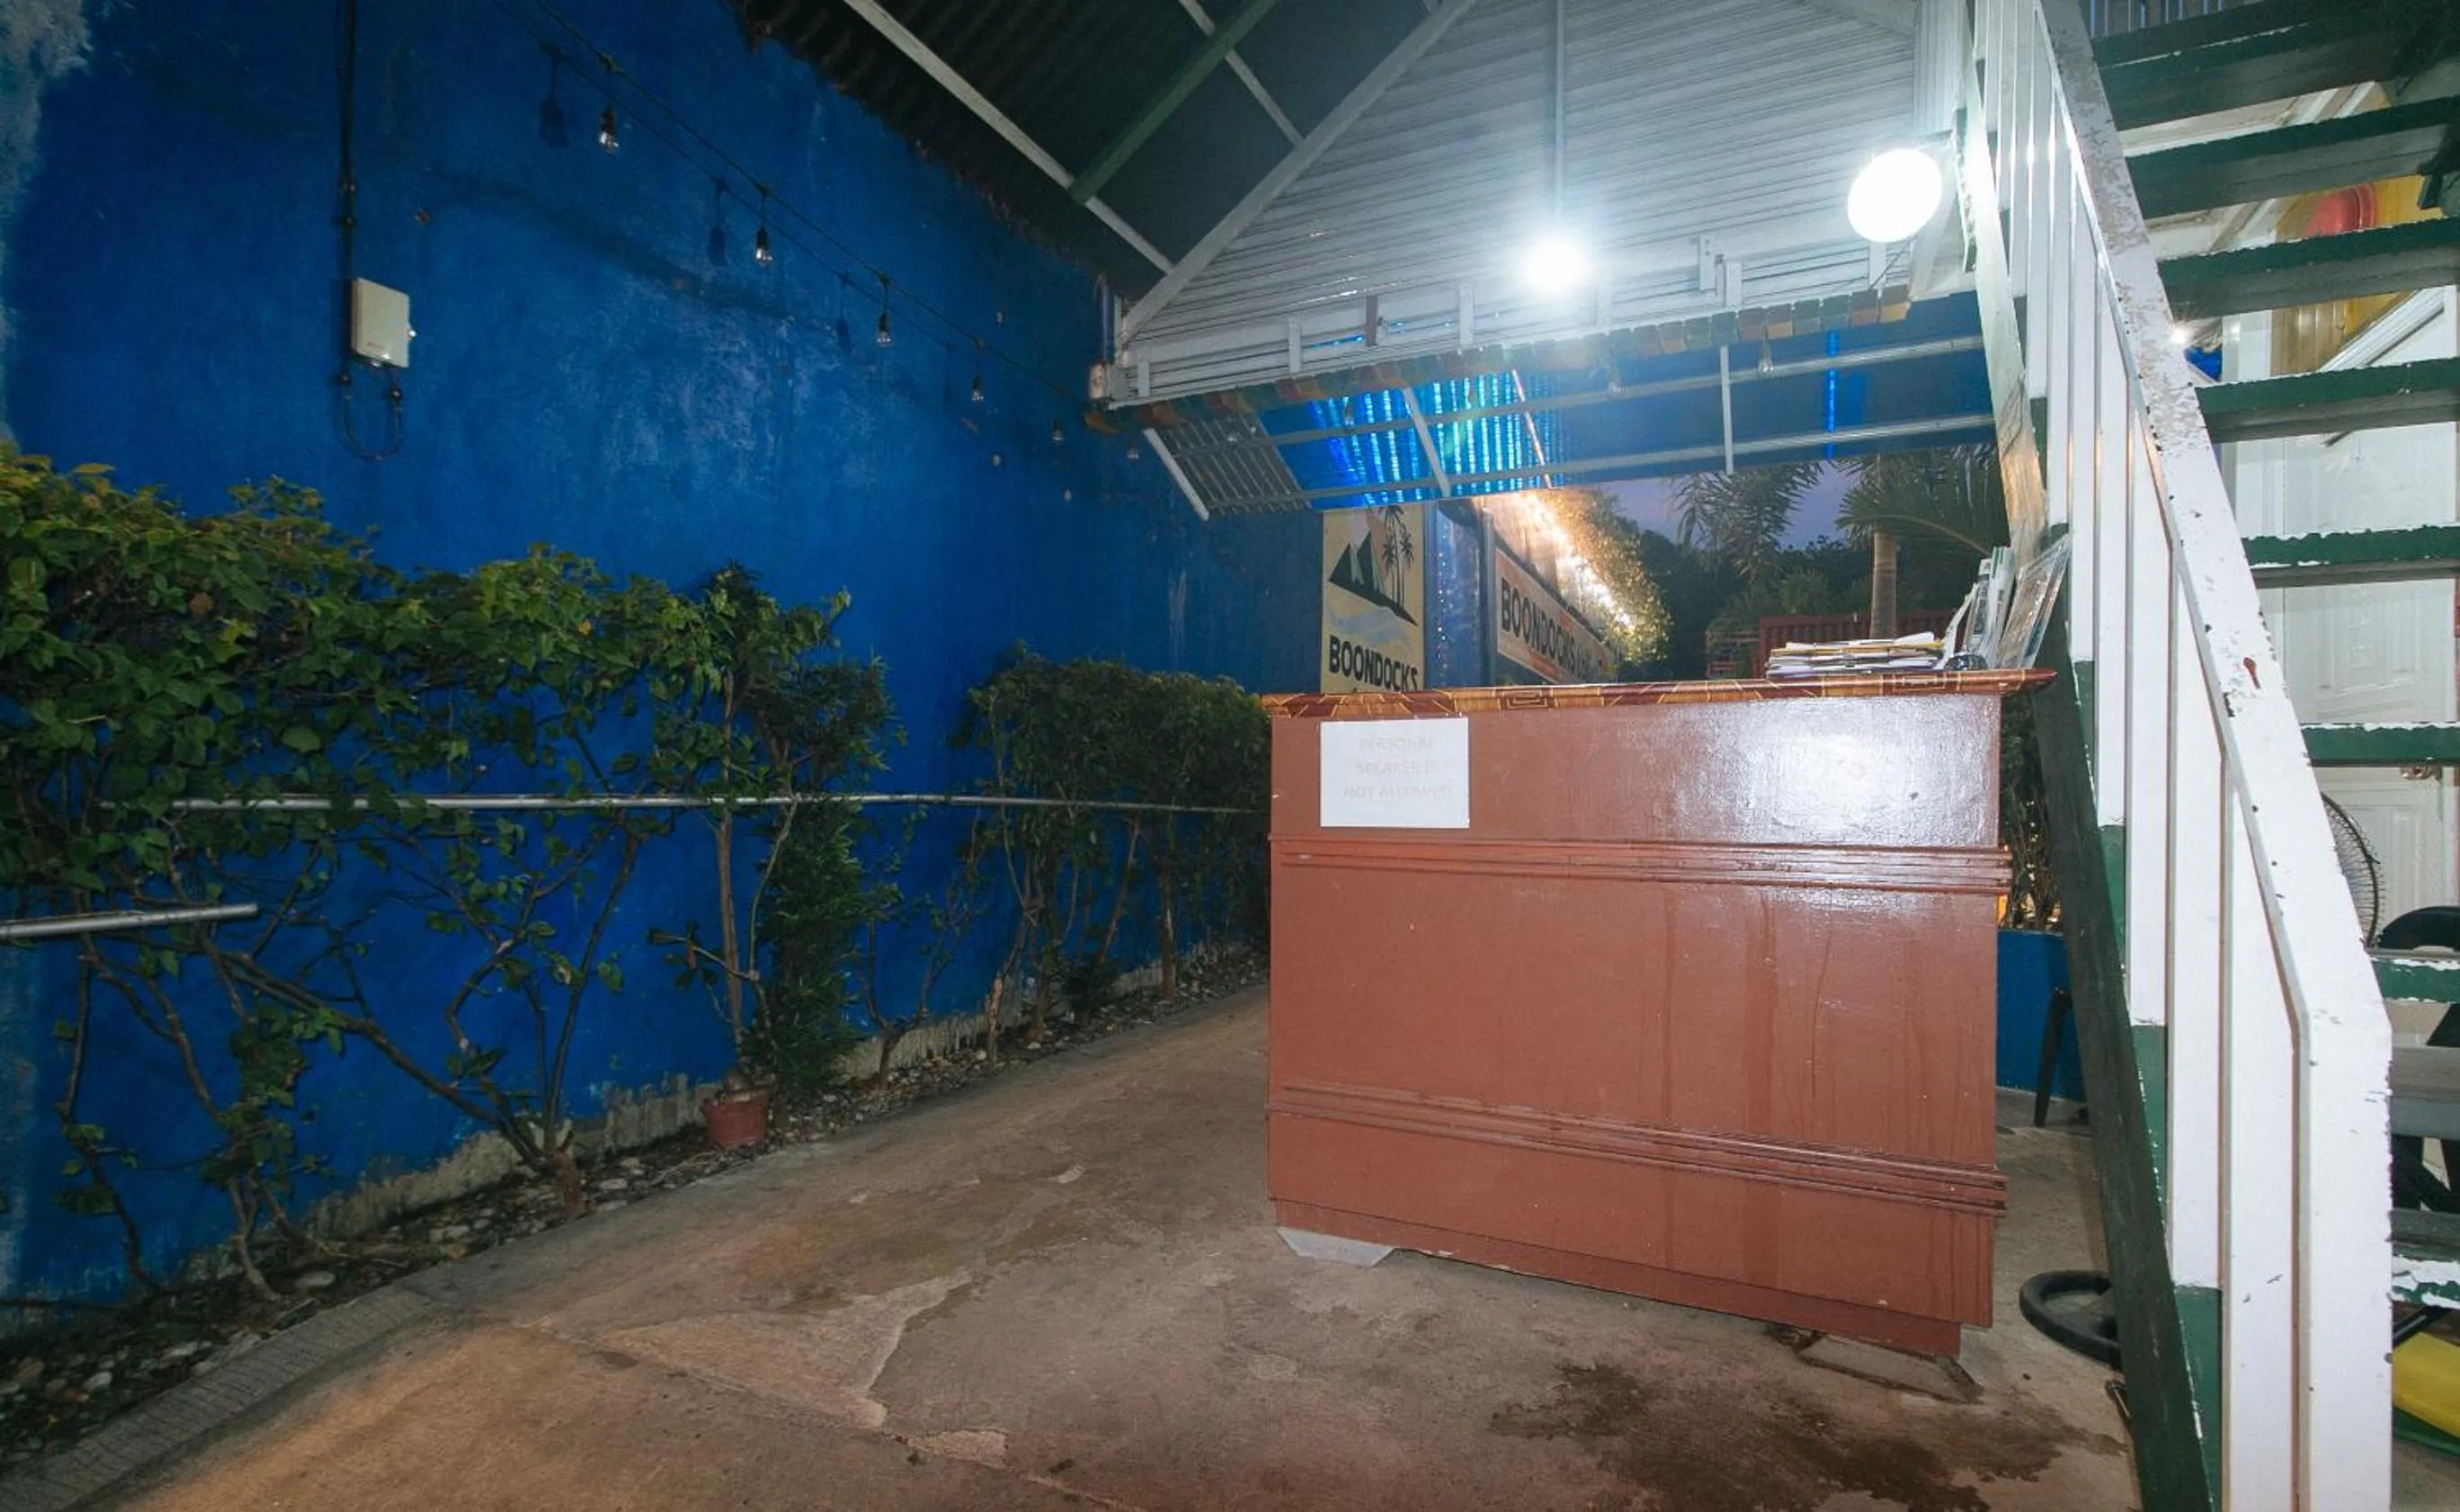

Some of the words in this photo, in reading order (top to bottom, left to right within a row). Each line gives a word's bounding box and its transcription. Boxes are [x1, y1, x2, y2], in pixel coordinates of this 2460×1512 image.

[1502, 577, 1575, 674] BOONDOCKS
[1329, 635, 1418, 691] BOONDOCKS
[1343, 785, 1375, 798] NOT
